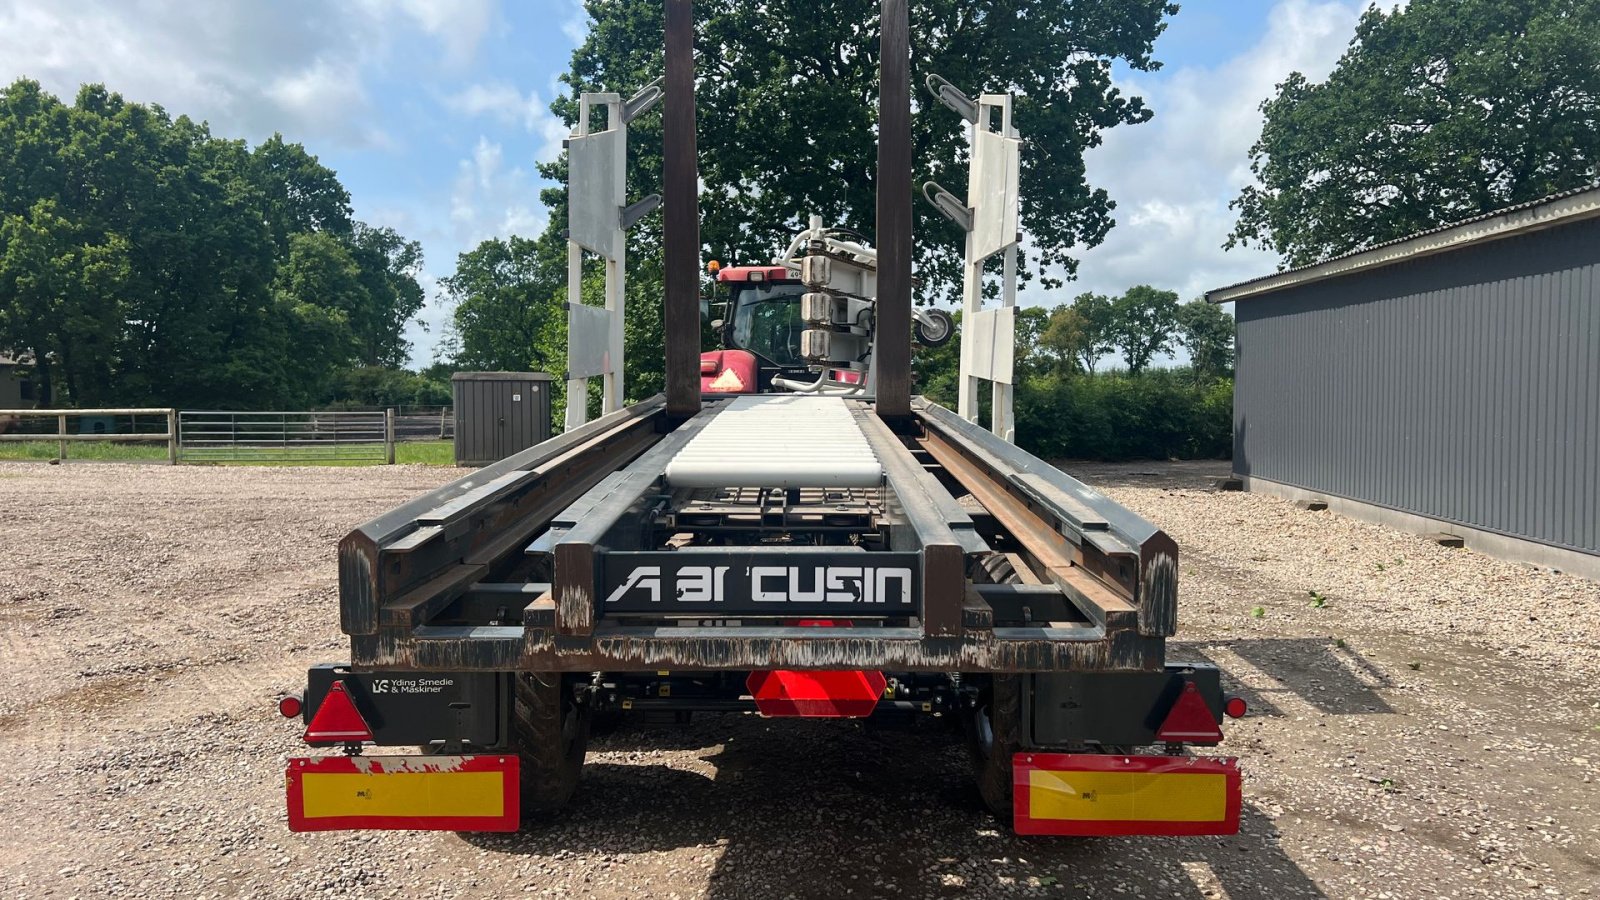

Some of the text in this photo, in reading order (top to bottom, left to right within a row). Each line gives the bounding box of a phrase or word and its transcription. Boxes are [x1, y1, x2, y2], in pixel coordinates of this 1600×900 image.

[390, 678, 454, 687] Yding Smedie
[391, 686, 399, 694] &
